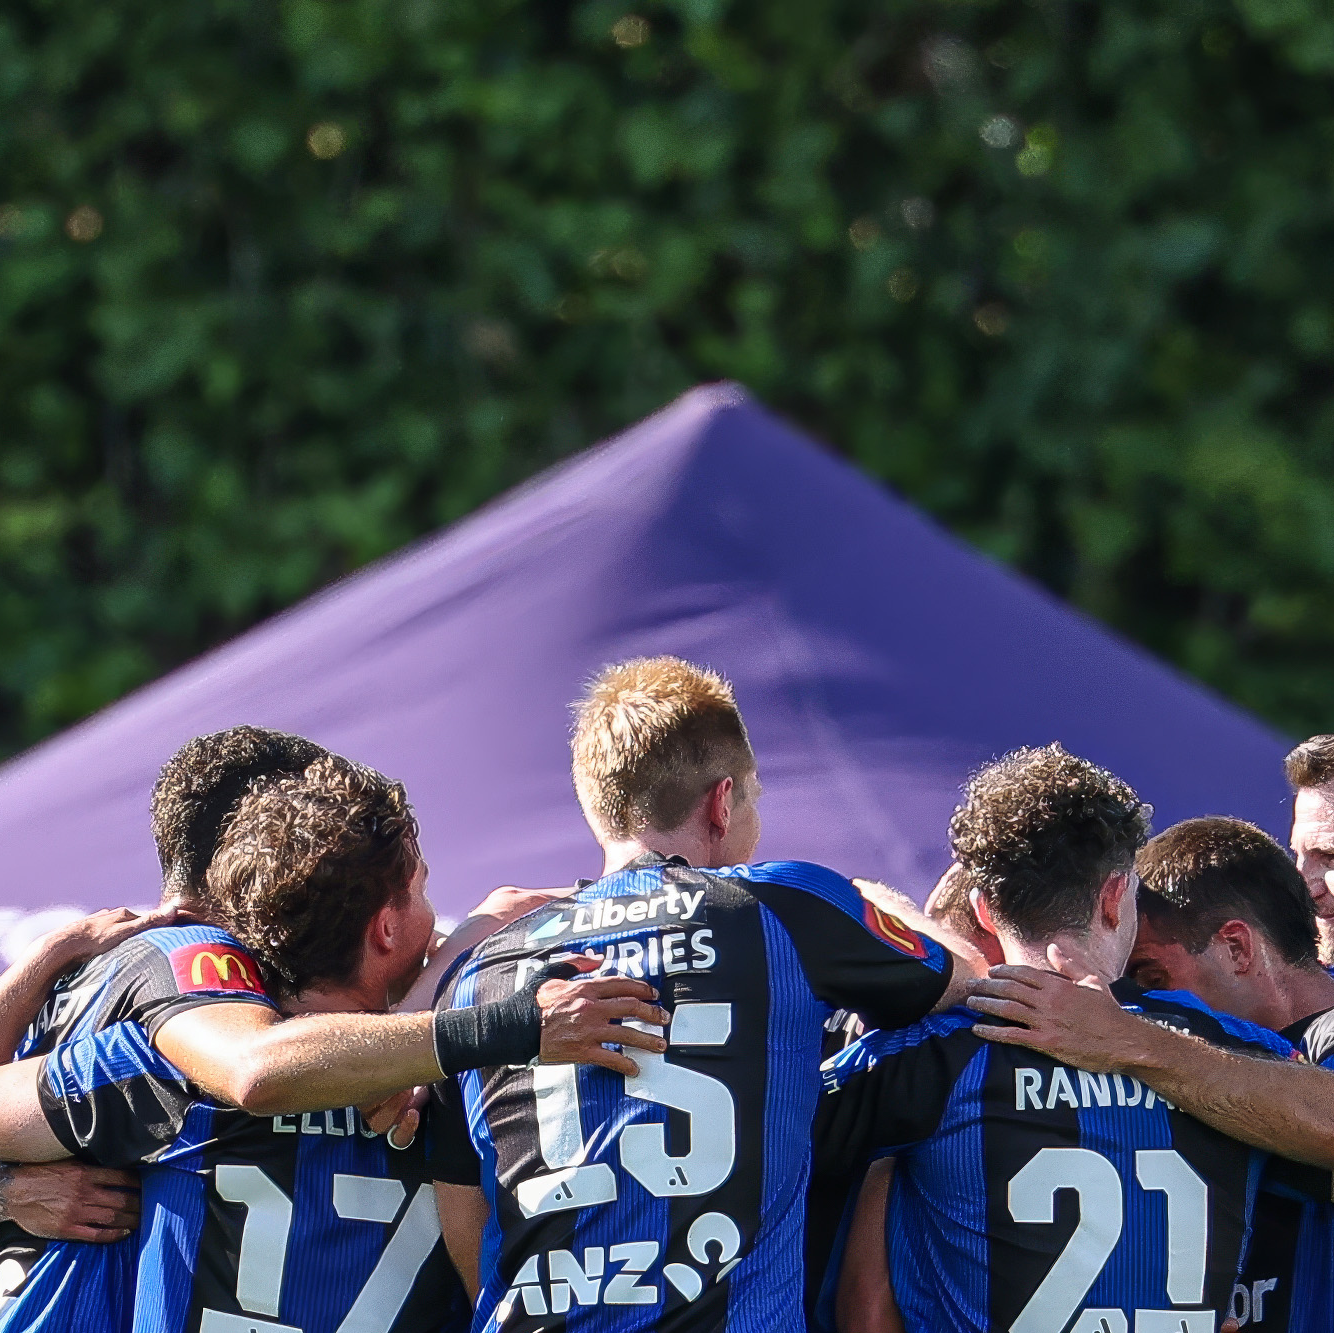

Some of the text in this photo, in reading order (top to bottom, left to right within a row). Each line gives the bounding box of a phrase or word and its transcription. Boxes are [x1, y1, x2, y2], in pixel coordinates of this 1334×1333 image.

[572, 884, 706, 934] Liberty
[272, 1105, 378, 1139] ELLI
[517, 1002, 736, 1220] 15
[497, 1241, 660, 1322] ANZ
